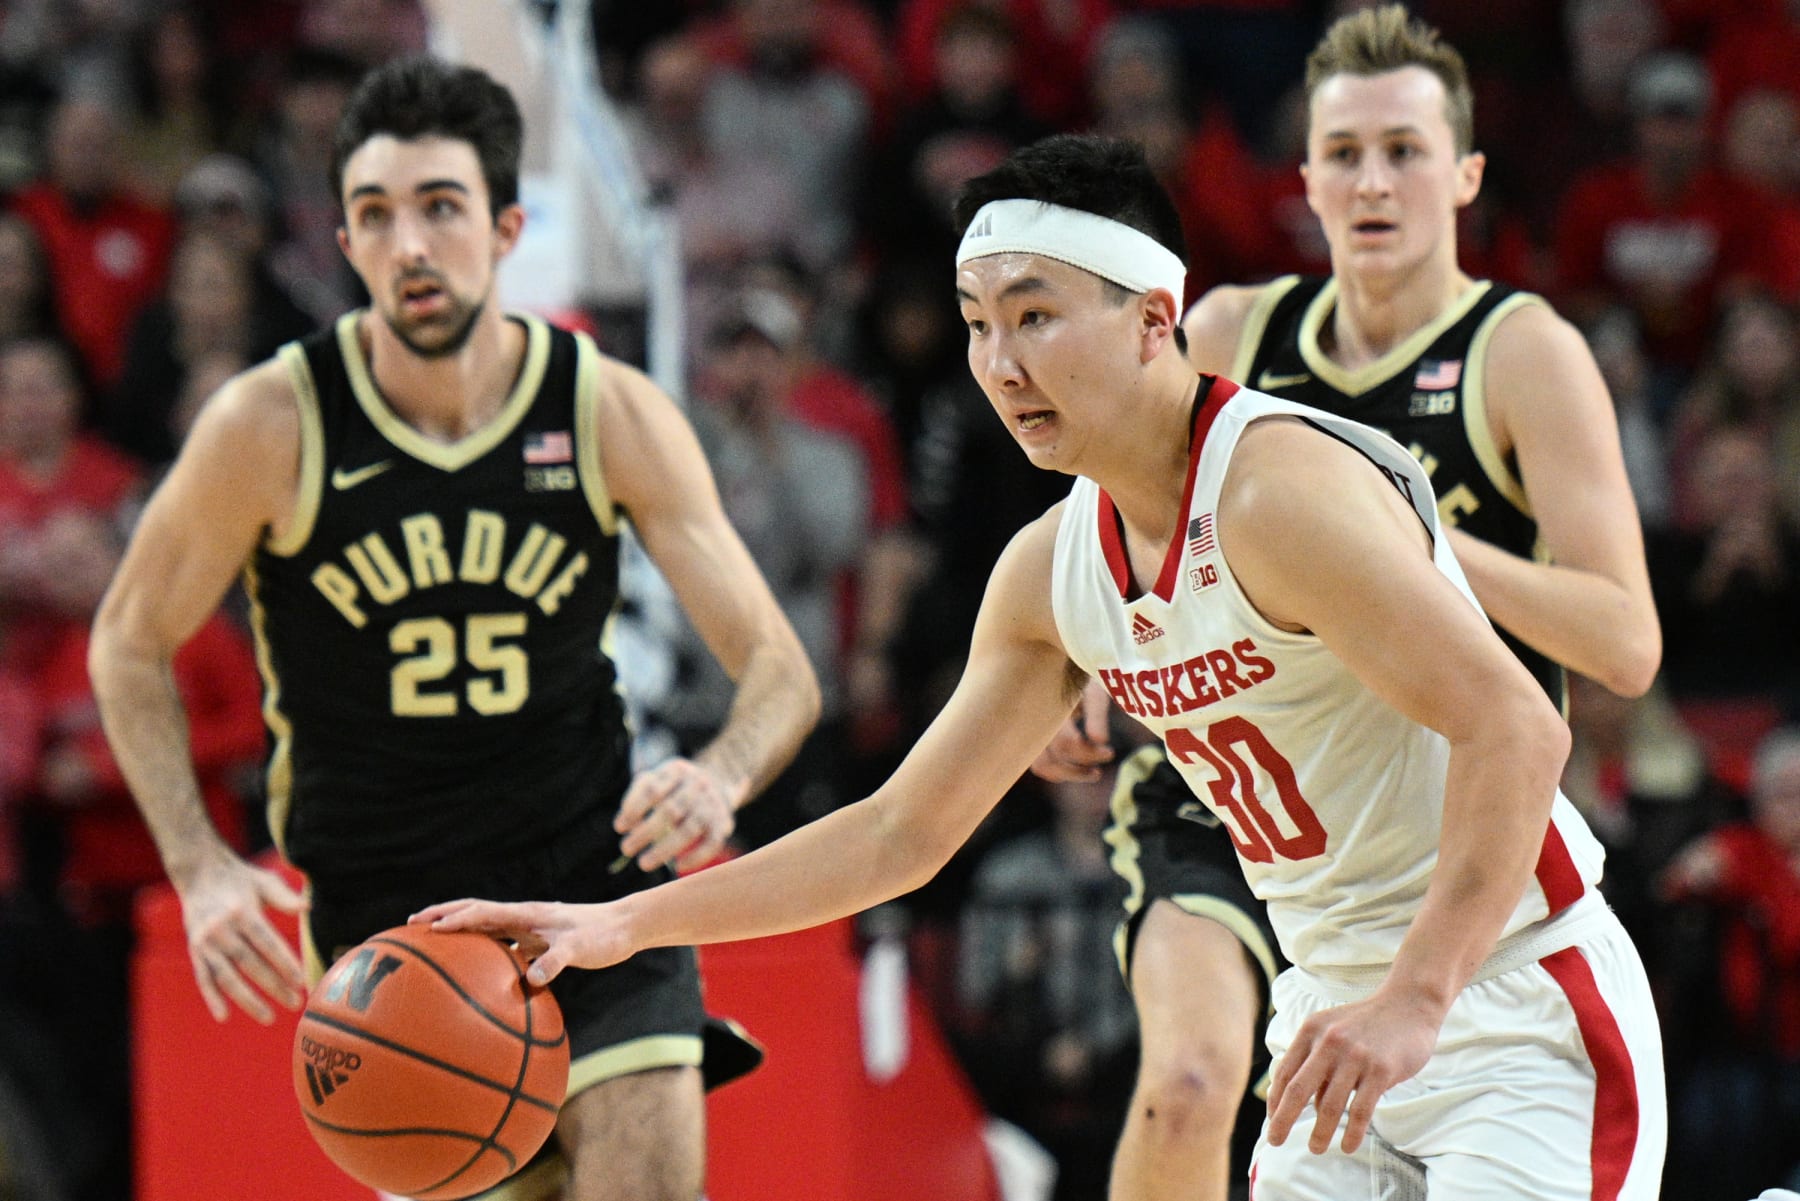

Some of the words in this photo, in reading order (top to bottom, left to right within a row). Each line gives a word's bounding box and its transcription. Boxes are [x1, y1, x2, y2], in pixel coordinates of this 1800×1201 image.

[311, 508, 589, 629] PURDUE
[389, 612, 530, 718] 25
[1133, 627, 1165, 646] adidas
[1165, 715, 1328, 864] 30
